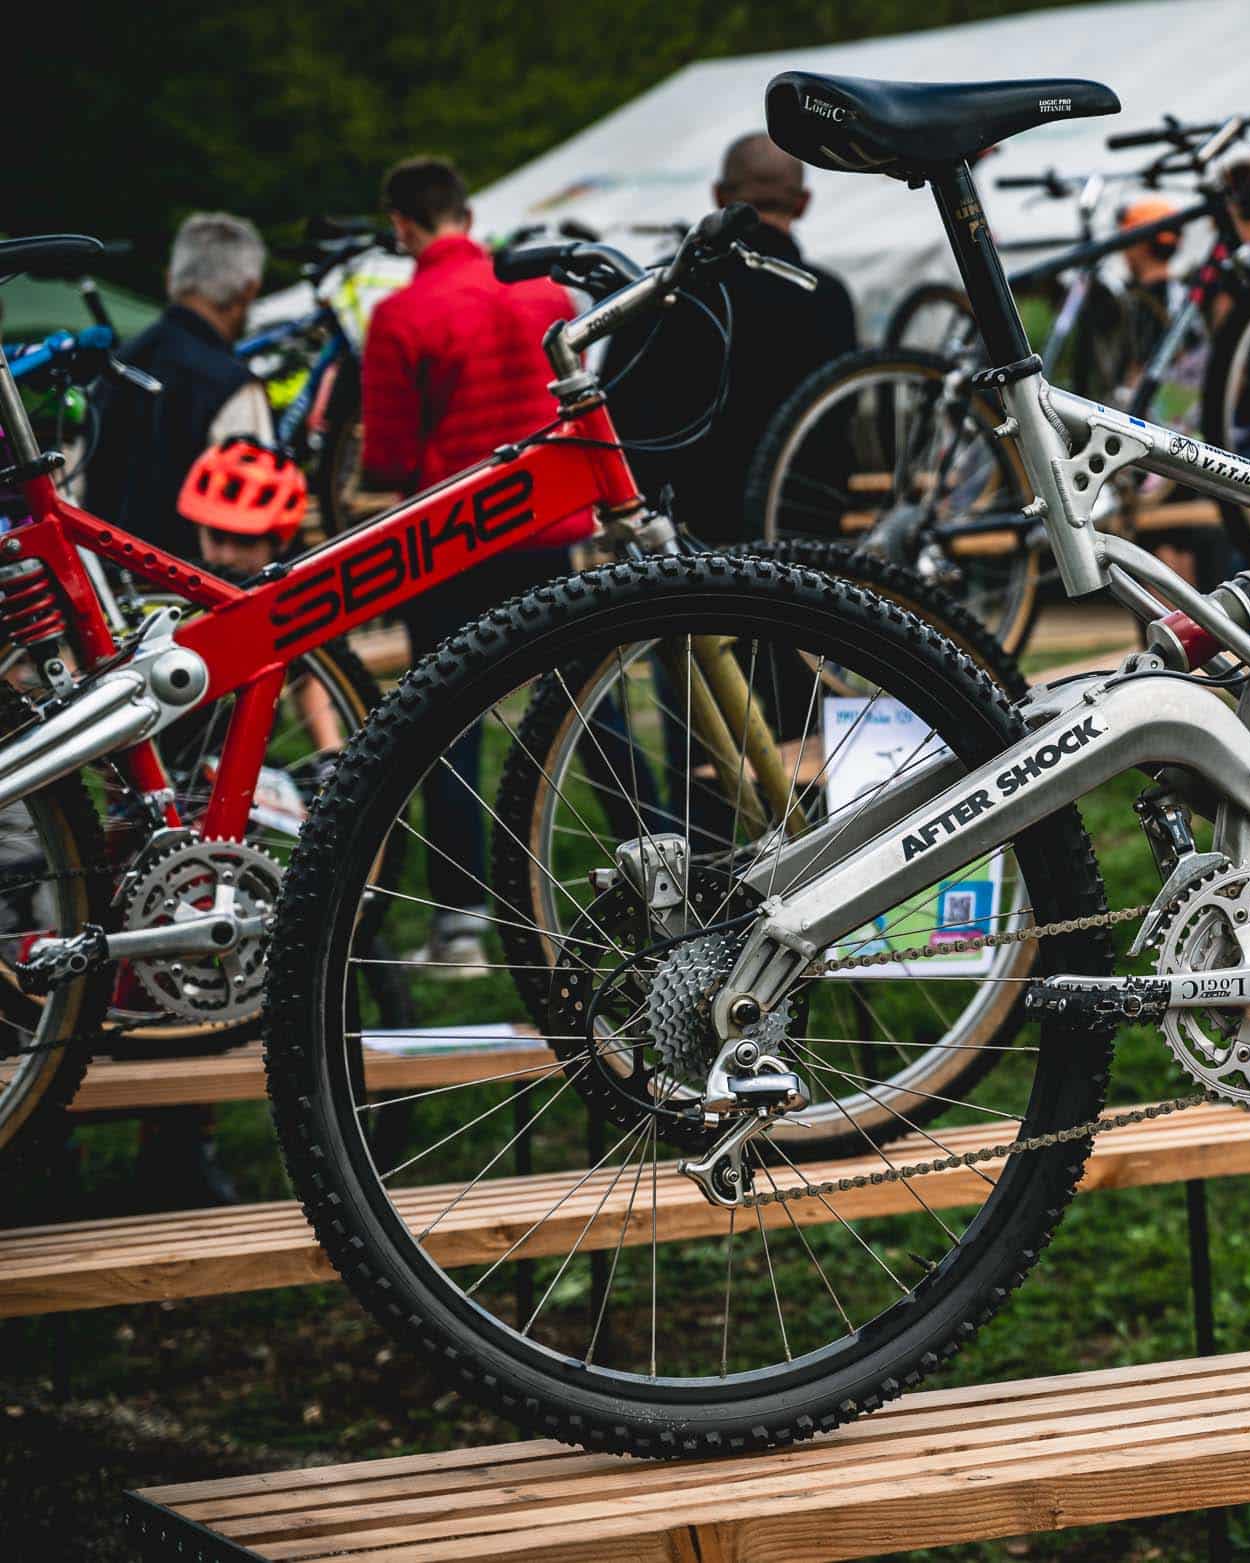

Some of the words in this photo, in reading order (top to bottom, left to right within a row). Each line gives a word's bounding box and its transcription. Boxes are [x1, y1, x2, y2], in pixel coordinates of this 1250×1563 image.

[1040, 105, 1071, 113] TITANIUM
[270, 469, 535, 651] SBIKE
[901, 789, 996, 862] AFTER
[996, 715, 1103, 798] SHOCK
[1182, 977, 1248, 999] LOGIC
